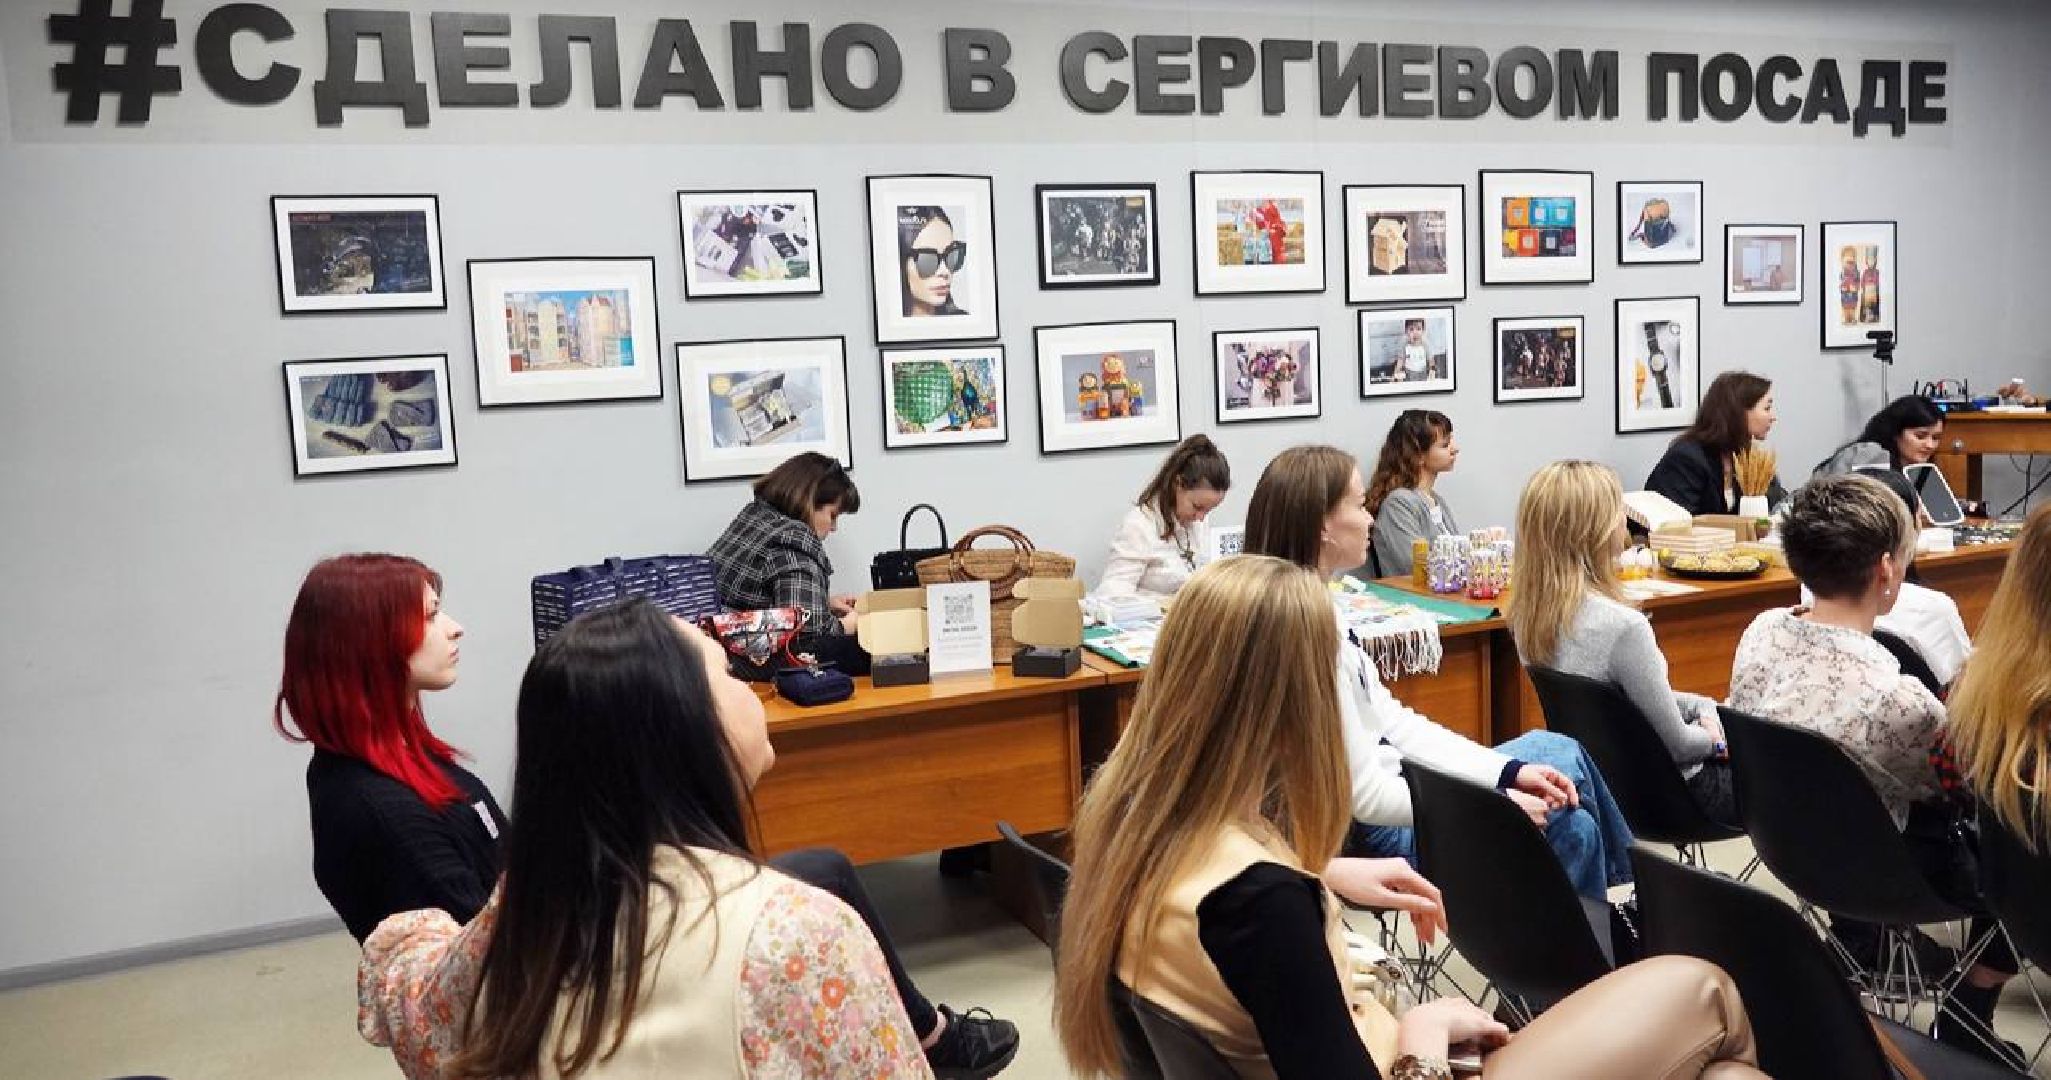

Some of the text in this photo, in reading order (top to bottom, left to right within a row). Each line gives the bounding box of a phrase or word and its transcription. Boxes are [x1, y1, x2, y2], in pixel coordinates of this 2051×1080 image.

[49, 0, 1948, 138] #СДЕЛАНО В СЕРГИЕВОМ ПОСАДЕ
